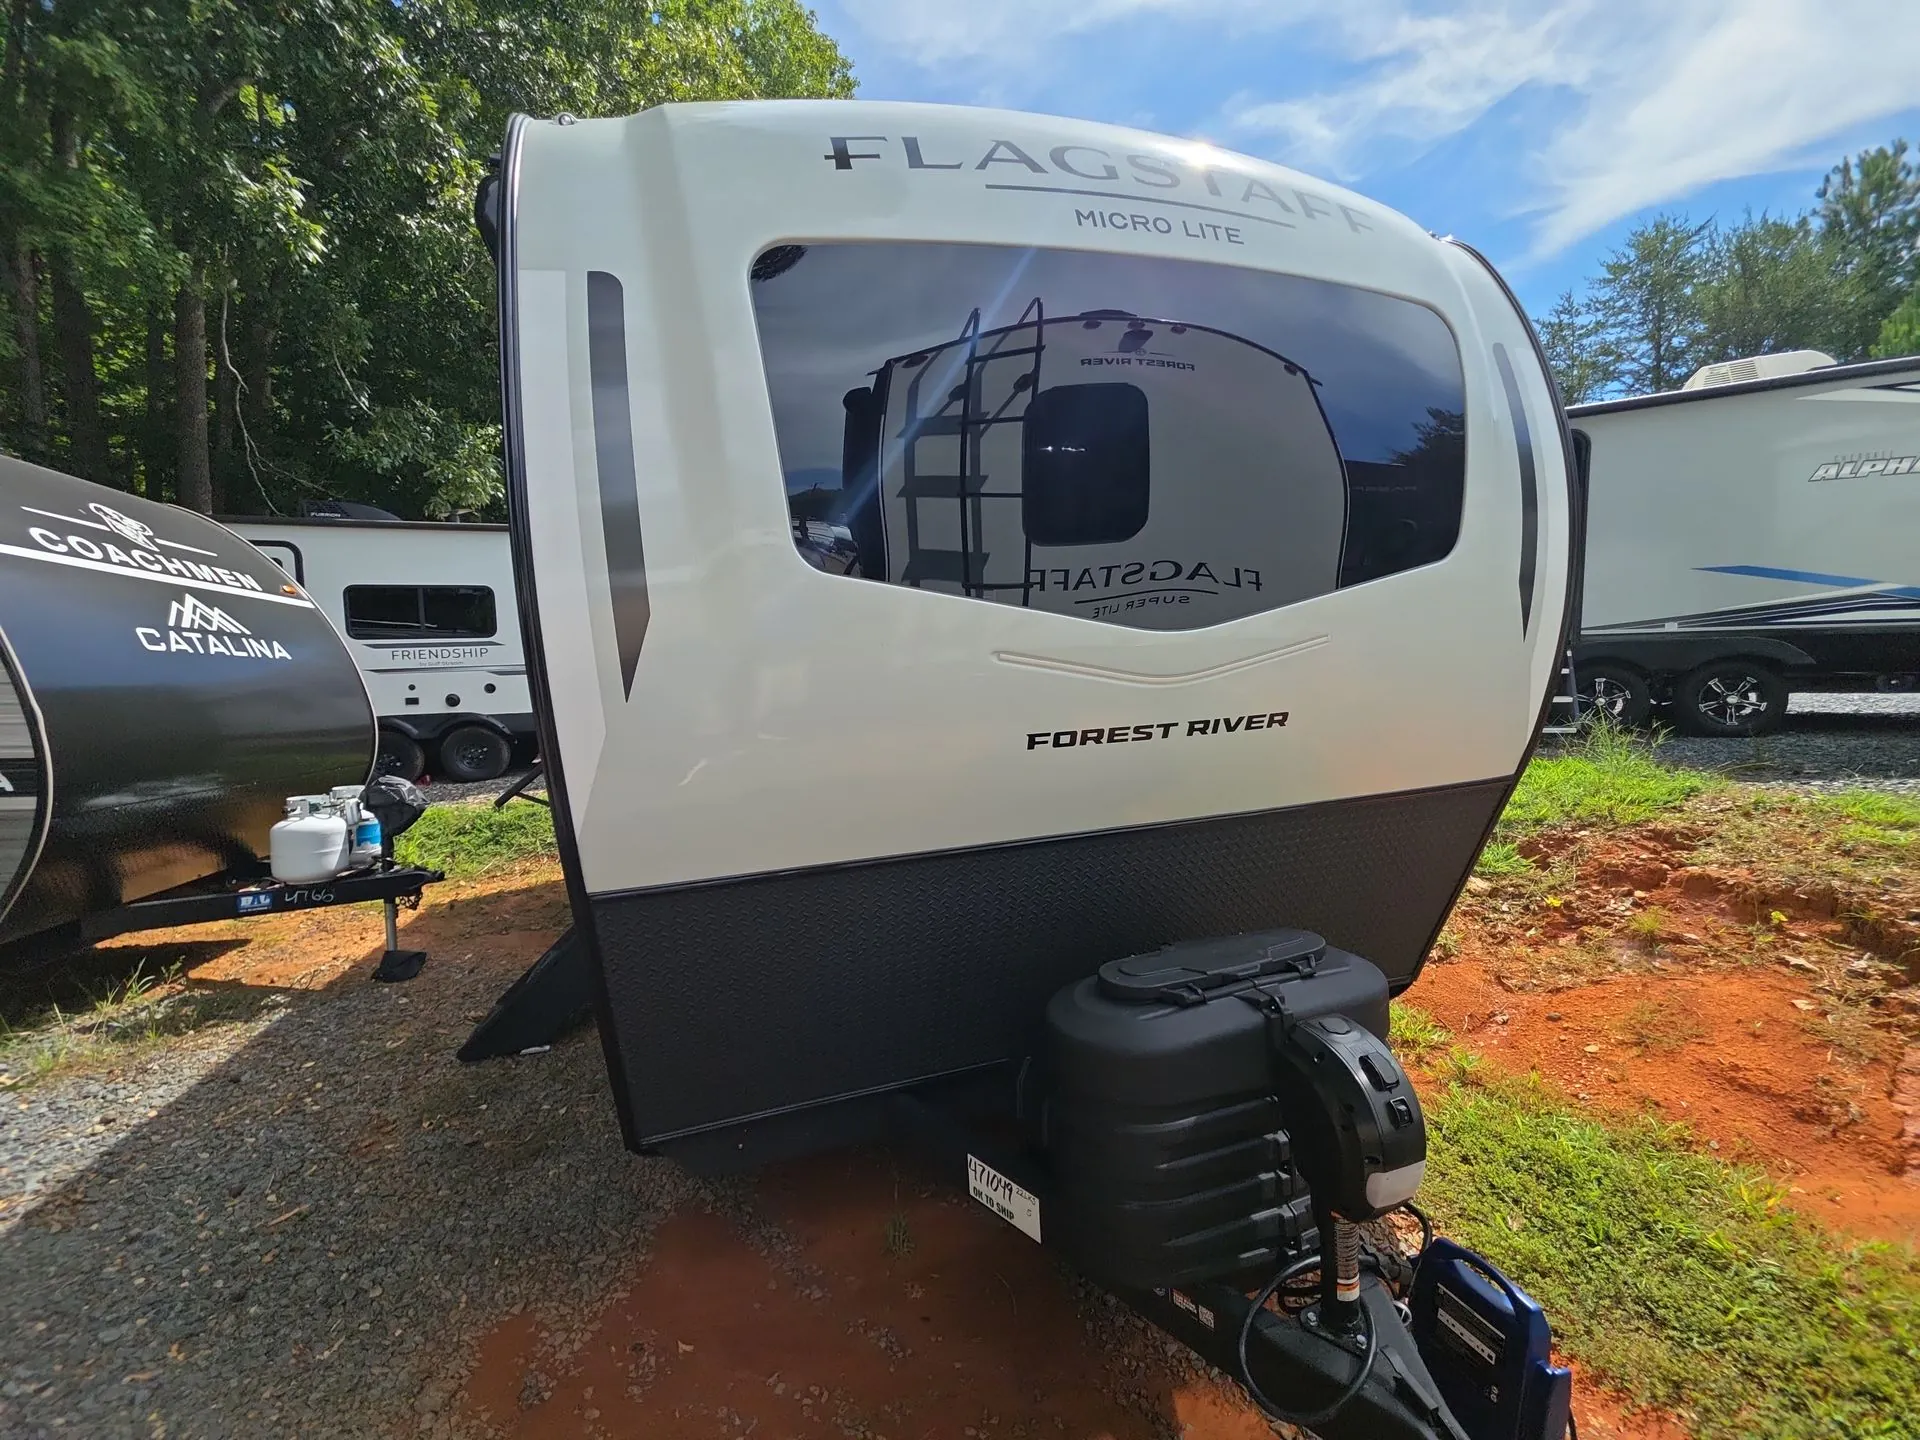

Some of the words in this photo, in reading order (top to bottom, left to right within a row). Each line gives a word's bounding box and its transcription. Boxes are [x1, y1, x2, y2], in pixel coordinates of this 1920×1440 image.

[824, 136, 1376, 235] FLAGSTAFF
[1074, 208, 1172, 234] MICRO
[1181, 220, 1245, 245] LITE
[28, 527, 263, 591] COACHMEN
[135, 626, 293, 660] CATALINA
[391, 647, 489, 660] FRIENDSHIP
[1026, 722, 1179, 750] FOREST
[1186, 711, 1290, 737] RIVER
[968, 1157, 1013, 1205] 471049
[973, 1186, 984, 1201] OK
[985, 1193, 995, 1208] TO
[996, 1202, 1015, 1221] SHIP
